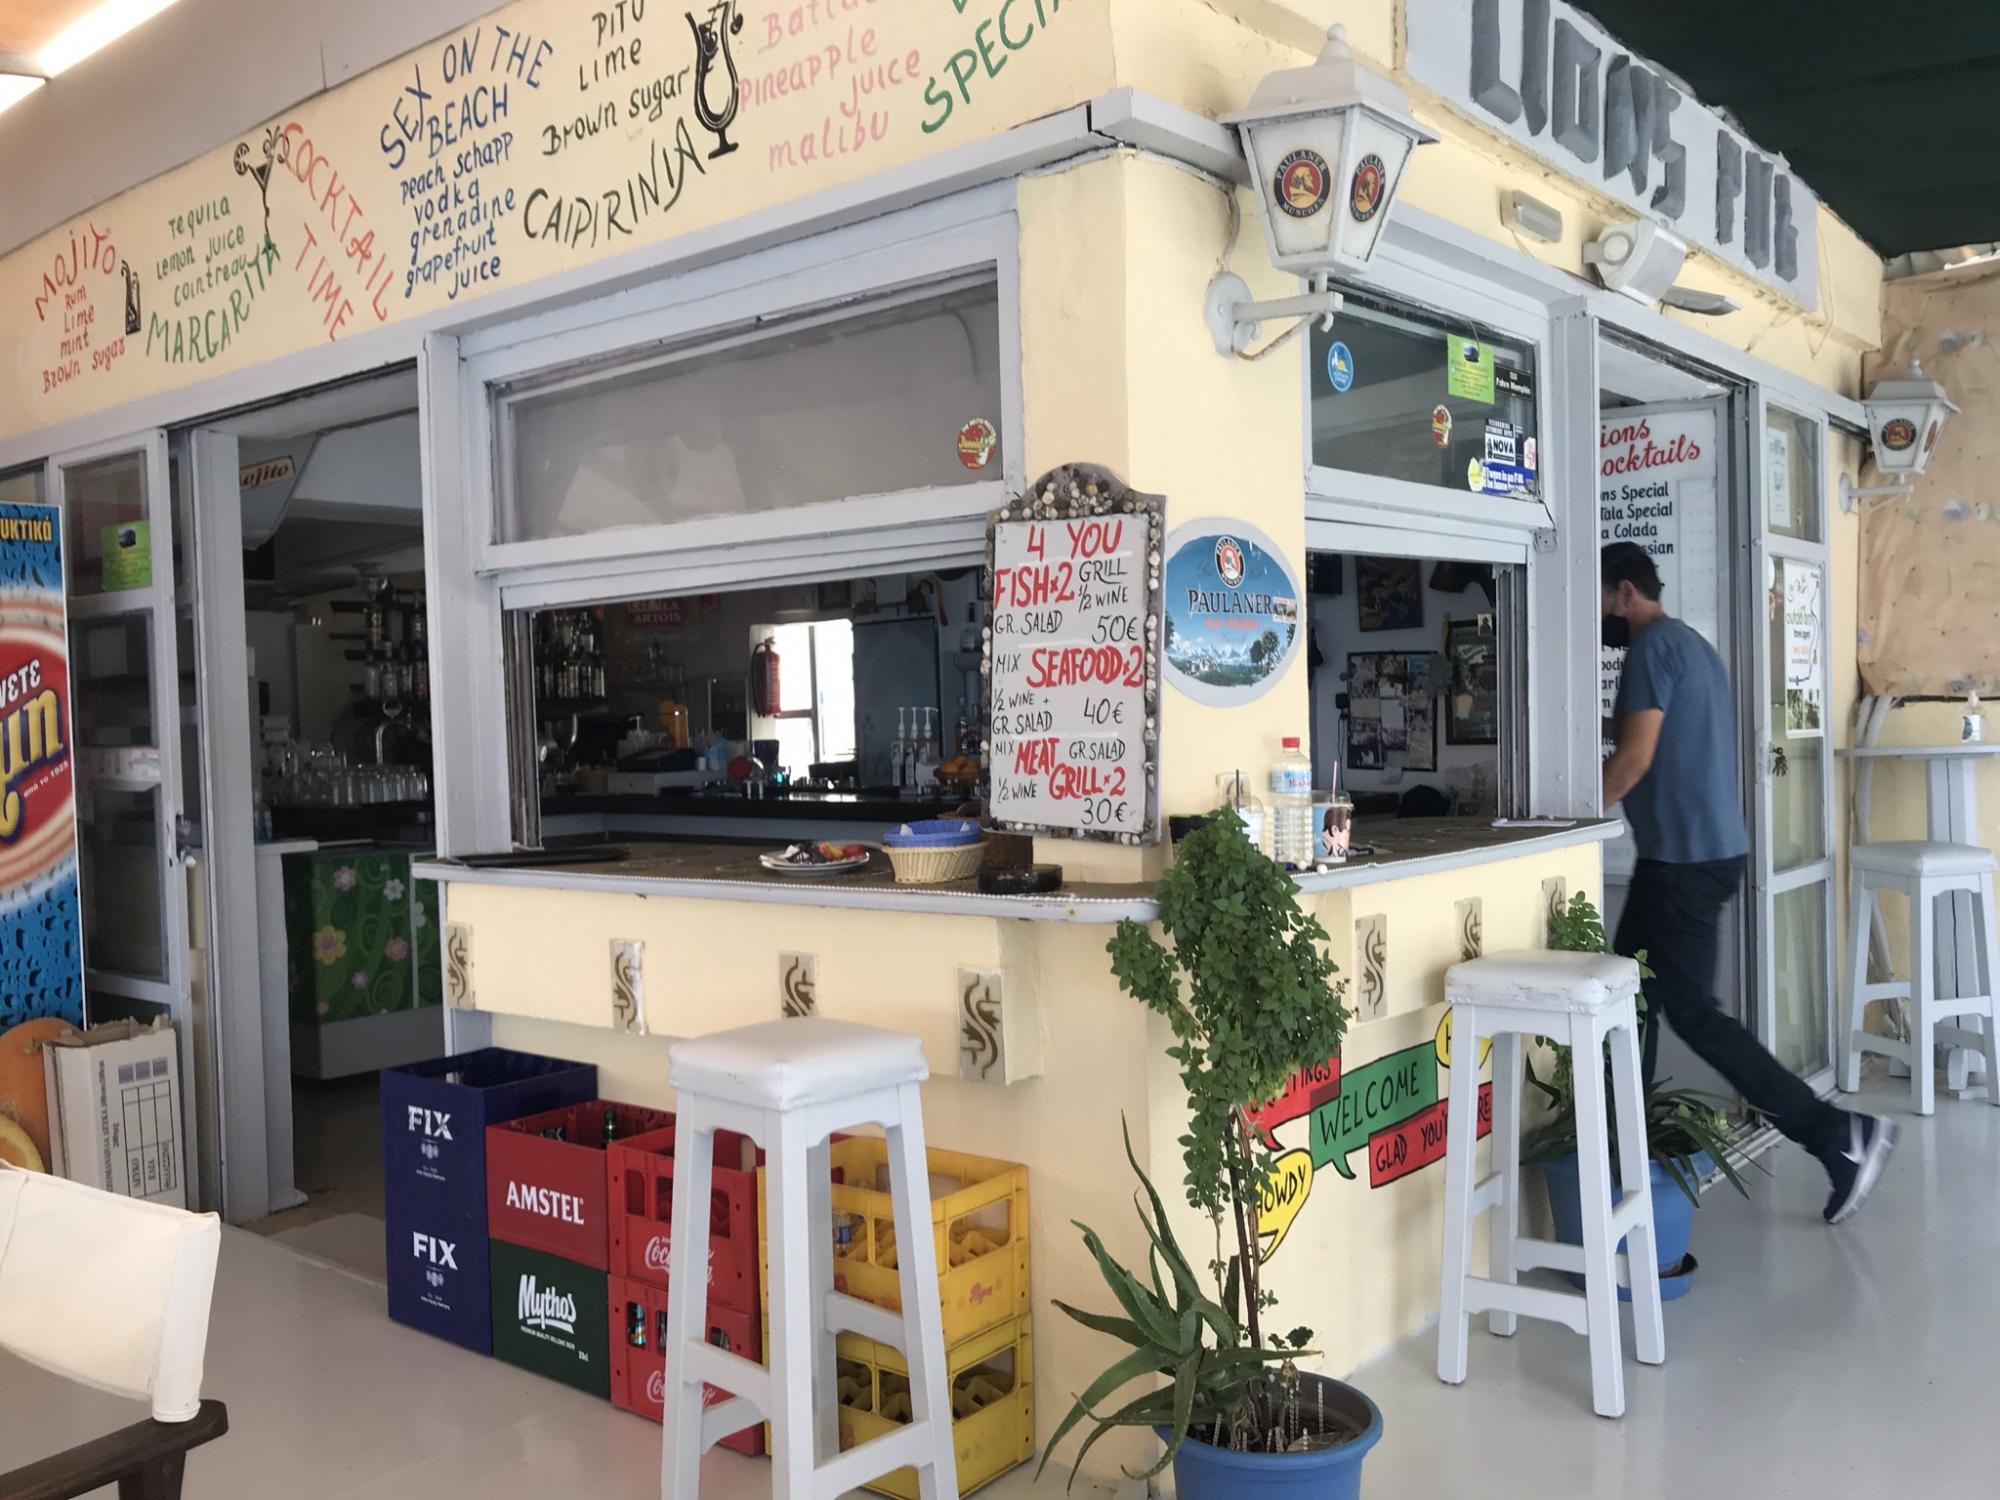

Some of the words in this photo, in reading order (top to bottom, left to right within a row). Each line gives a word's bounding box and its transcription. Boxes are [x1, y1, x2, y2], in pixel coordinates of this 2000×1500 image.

[738, 25, 878, 113] pineapple
[839, 50, 921, 118] juice
[921, 0, 1074, 134] SPECI
[380, 62, 432, 169] SEX
[442, 27, 481, 84] ON
[490, 25, 554, 89] THE
[542, 102, 619, 156] Brown
[628, 66, 690, 122] sugar
[426, 82, 508, 159] BEACH
[768, 111, 890, 171] malibu
[400, 160, 446, 204] peach
[453, 131, 514, 180] schapp
[1276, 150, 1328, 180] PAULANER
[412, 177, 480, 226] vodka
[409, 186, 517, 266] grenadine
[404, 219, 498, 299] grapefruit
[447, 255, 501, 300] juice
[294, 222, 354, 342] TIME
[1492, 438, 1515, 455] NOVA
[240, 464, 289, 489] ojito
[1621, 481, 1670, 502] Special
[1614, 521, 1658, 539] Colada
[1626, 501, 1673, 522] Special
[1026, 524, 1045, 562] 4
[1066, 519, 1123, 560] YOU
[1078, 557, 1129, 585] GRILL
[1095, 585, 1129, 607] WINE
[1187, 587, 1273, 615] PAULANER
[1020, 609, 1063, 636] SALAD
[1091, 614, 1140, 645] 50€
[994, 653, 1022, 675] MIX
[1008, 690, 1035, 710] WINE
[1083, 696, 1125, 726] 40€
[1014, 710, 1053, 735] SALAD
[1014, 736, 1060, 776] MEAT
[1012, 779, 1038, 801] WINE
[1080, 797, 1128, 826] 30€
[407, 1104, 454, 1141] FIX
[1319, 1060, 1420, 1147] WELCOME
[1375, 1133, 1408, 1173] GLAD
[505, 1180, 585, 1225] AMSTEL
[412, 1230, 459, 1271] FIX
[518, 1273, 577, 1330] Mythos
